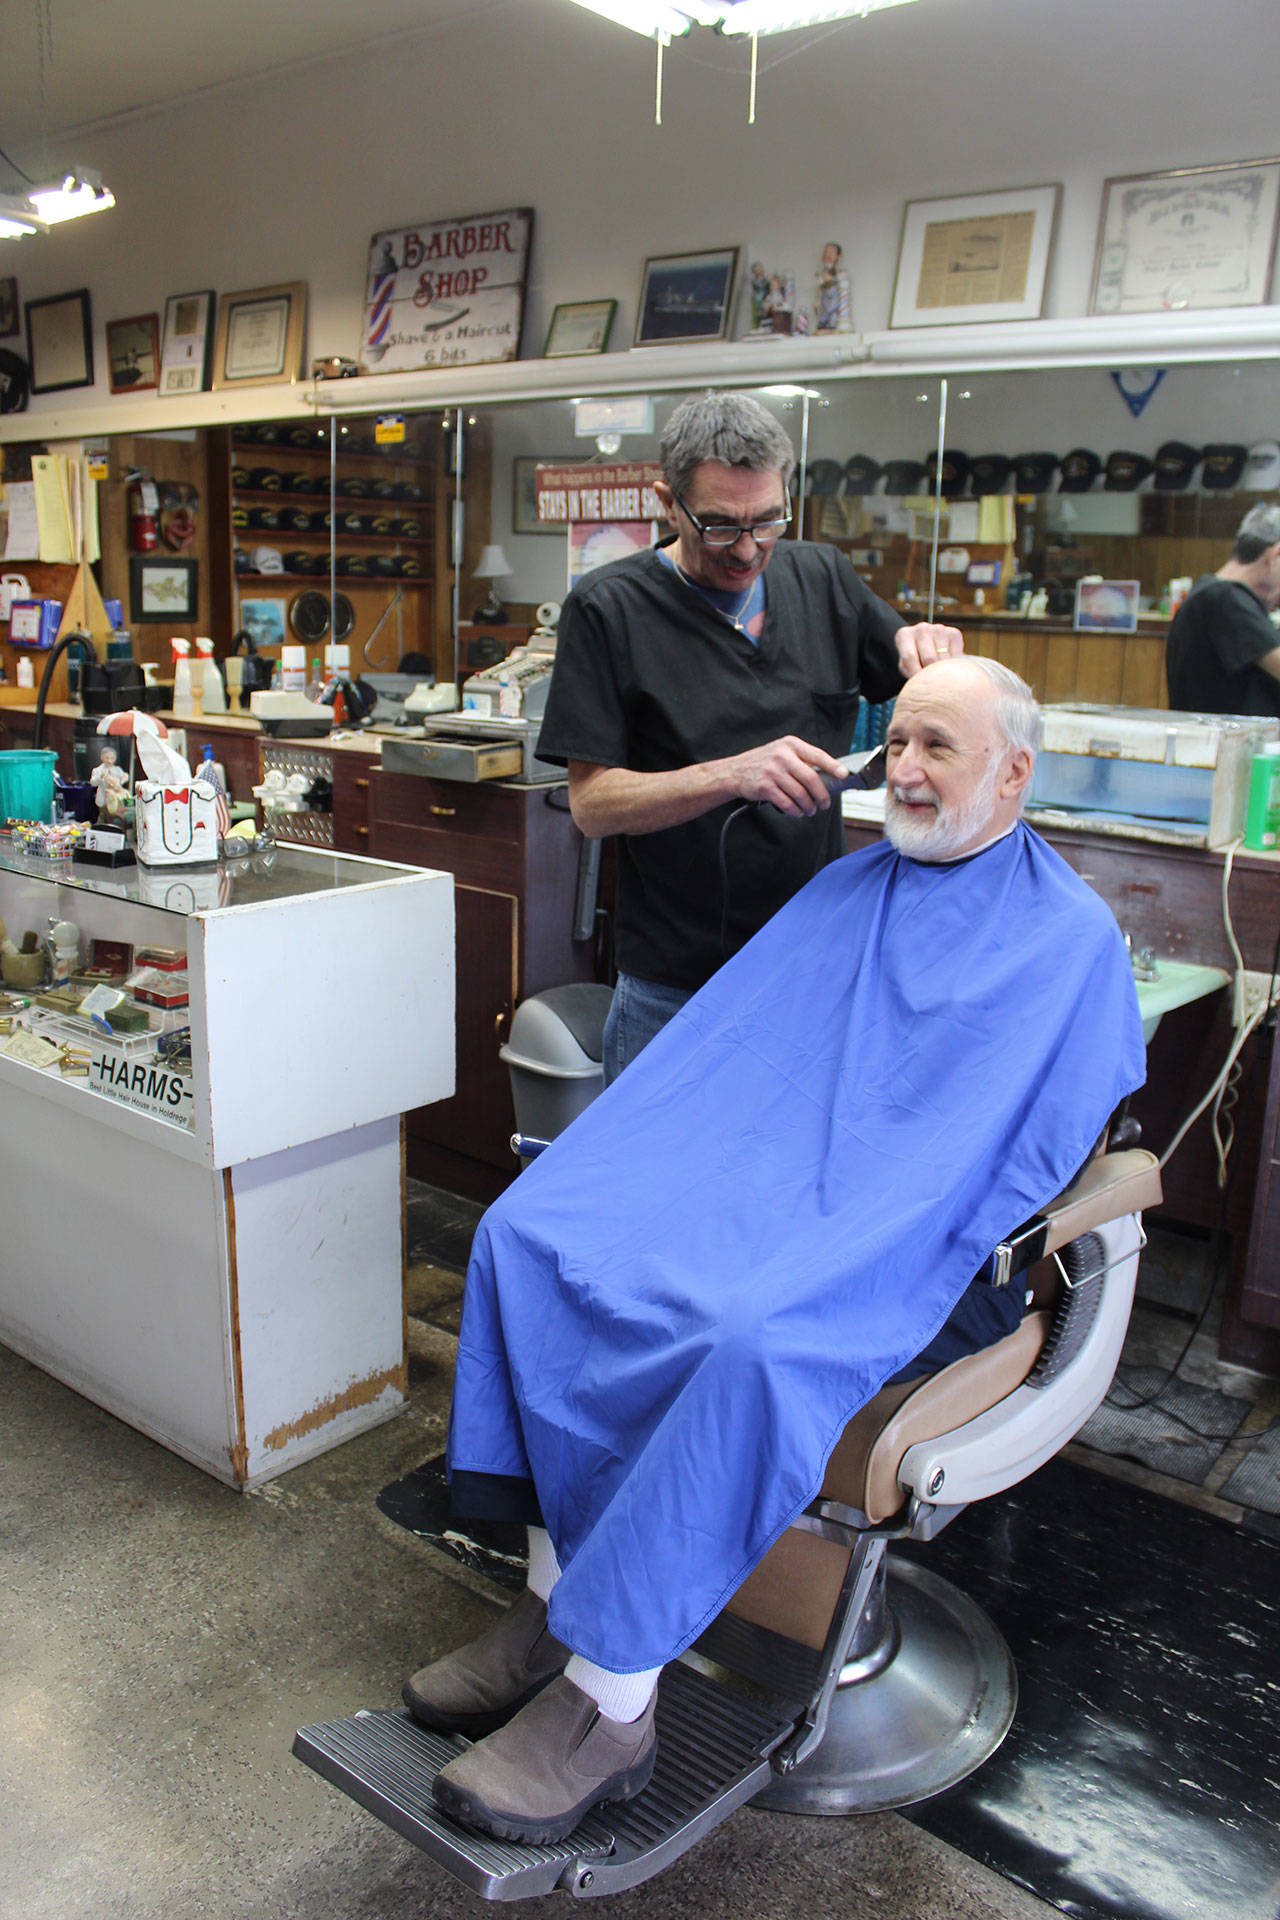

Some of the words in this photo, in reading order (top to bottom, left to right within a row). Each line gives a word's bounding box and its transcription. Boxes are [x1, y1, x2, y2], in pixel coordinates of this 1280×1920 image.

[402, 221, 515, 269] BARBER
[413, 267, 489, 308] SHOP
[389, 331, 427, 346] Shave
[457, 322, 512, 339] Haircut
[424, 349, 436, 362] 6
[440, 345, 467, 362] bits
[539, 490, 567, 520] STAYS
[567, 490, 580, 520] IN
[581, 489, 601, 520] THE
[601, 488, 640, 519] BARBER
[131, 1096, 150, 1111] House
